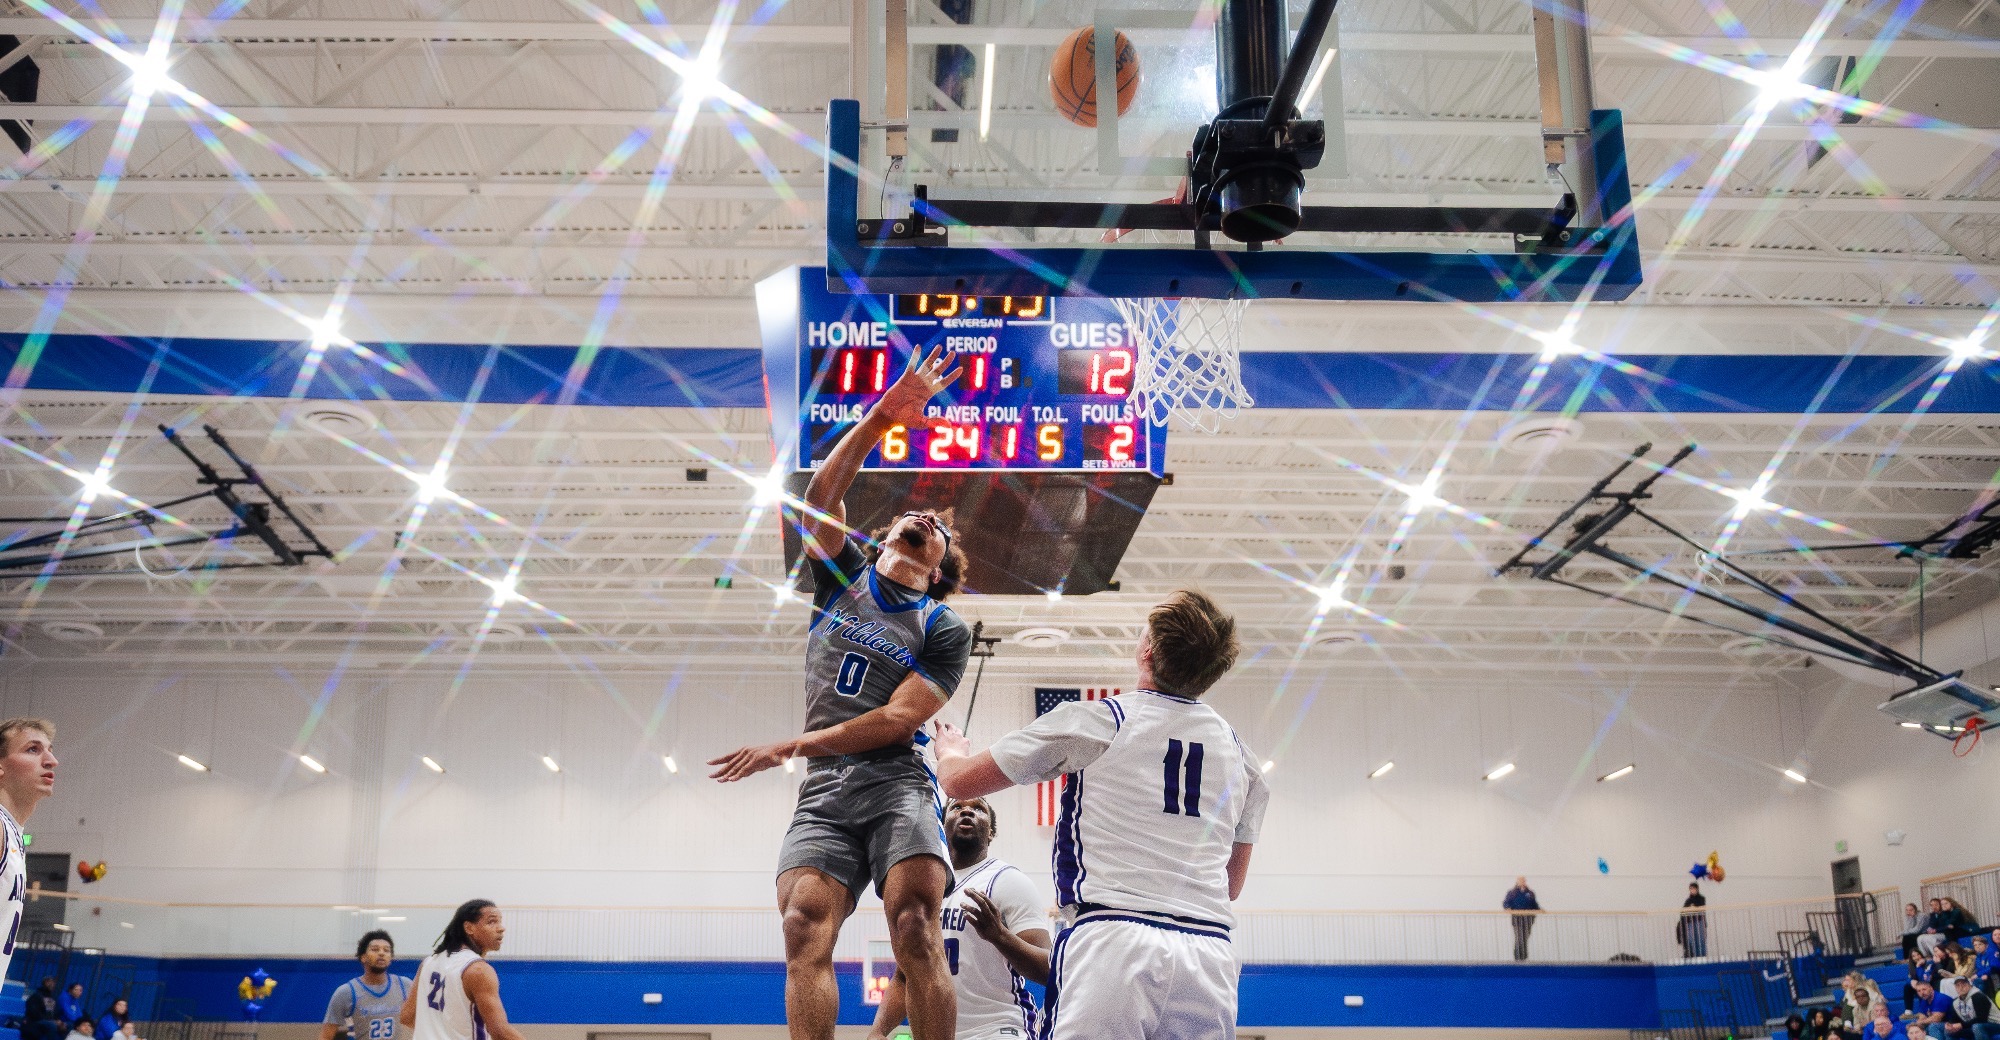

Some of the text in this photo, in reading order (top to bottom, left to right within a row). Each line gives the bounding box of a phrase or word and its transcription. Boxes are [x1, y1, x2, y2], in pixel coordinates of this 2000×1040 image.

[808, 321, 888, 347] HOME
[946, 336, 998, 353] PERIOD
[1050, 322, 1136, 348] GUEST
[843, 352, 885, 392] 11
[974, 357, 985, 388] 1
[1090, 350, 1132, 395] 12
[810, 403, 863, 423] FOULS
[927, 405, 1022, 423] PLAYER FOUL
[1031, 406, 1069, 423] T.O.L.
[1081, 404, 1135, 423] FOULS
[883, 425, 907, 460] 6
[929, 426, 980, 461] 24
[1006, 427, 1017, 458] 1
[1039, 425, 1061, 460] 5
[1109, 425, 1134, 460] 2
[1082, 460, 1136, 468] SETS WON
[823, 608, 914, 667] Wildcats
[834, 651, 871, 698] 0
[1162, 737, 1204, 817] 11
[940, 908, 968, 932] RED
[369, 1017, 395, 1040] 23
